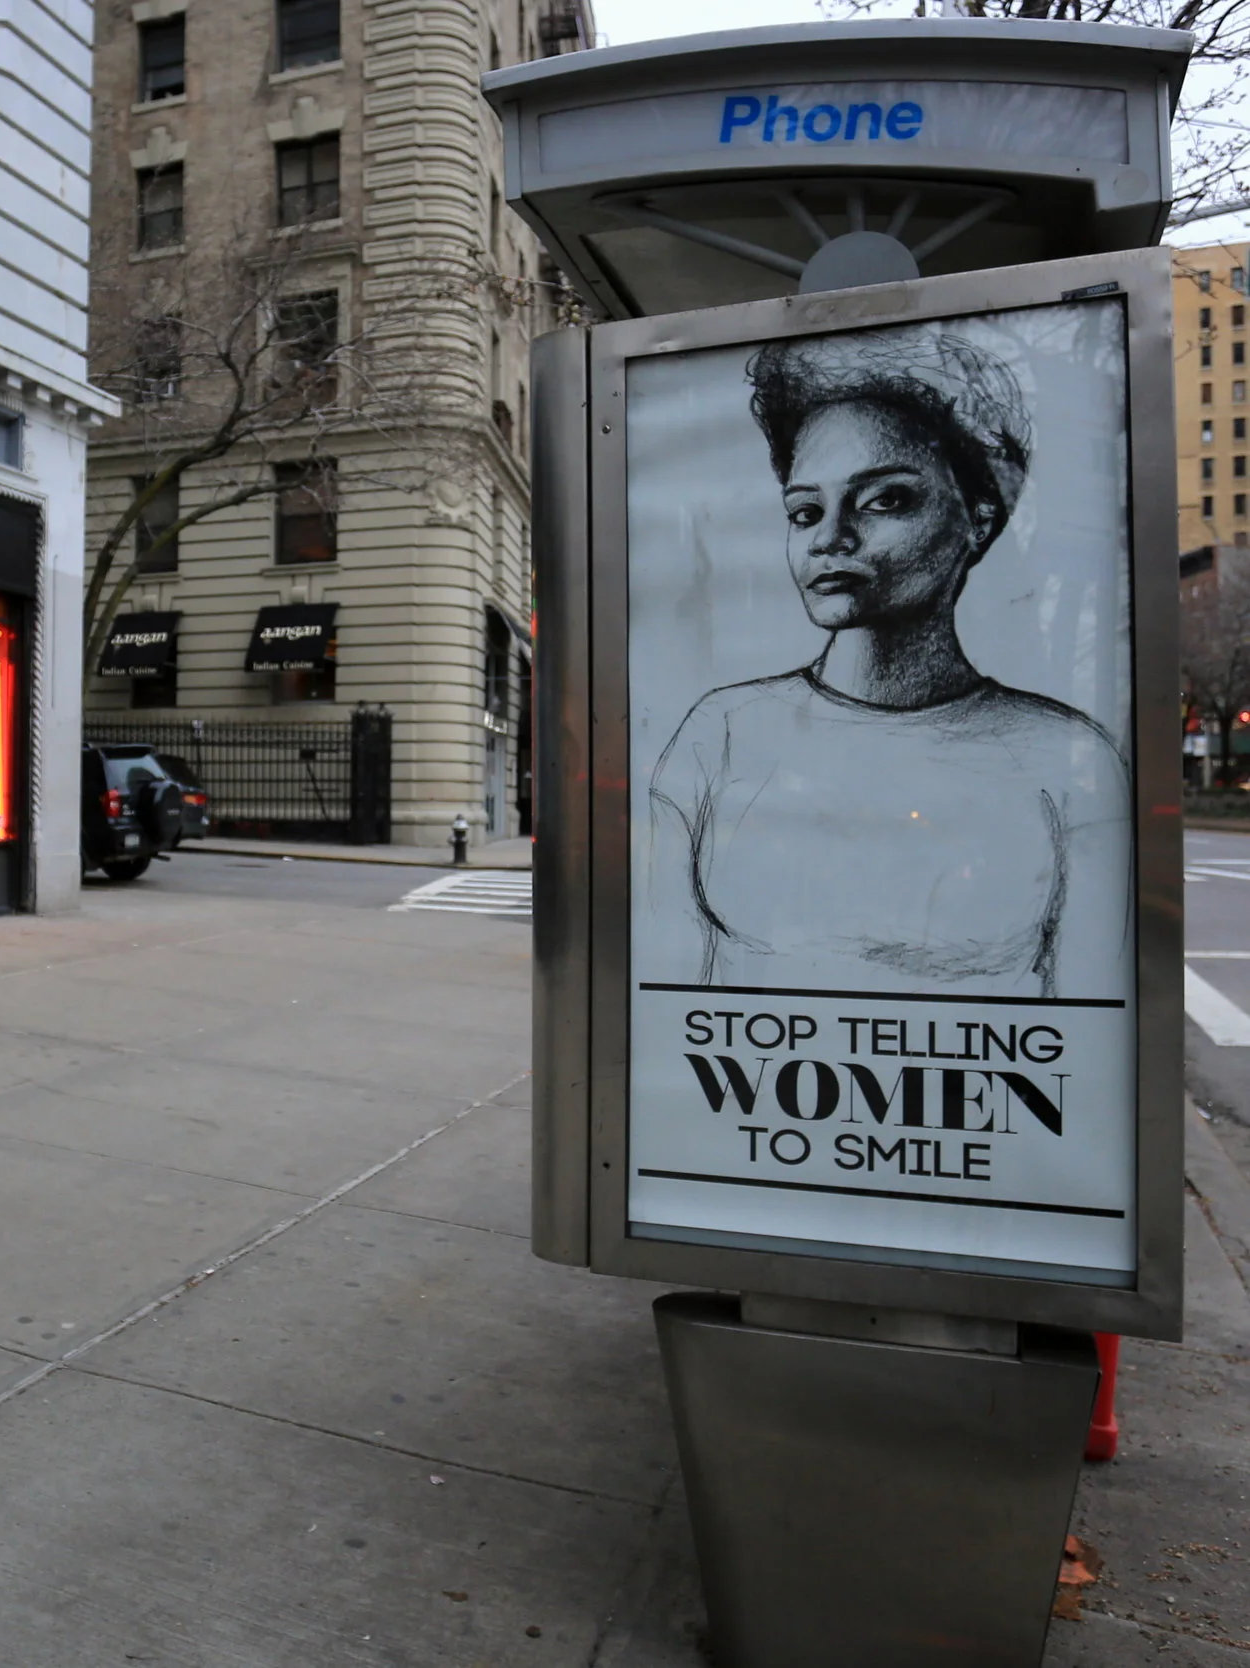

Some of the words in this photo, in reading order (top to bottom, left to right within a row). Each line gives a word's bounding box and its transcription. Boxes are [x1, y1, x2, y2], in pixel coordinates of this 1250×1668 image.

[719, 95, 924, 143] Phone
[111, 632, 168, 647] aangan
[260, 625, 322, 640] aangan
[253, 661, 279, 671] Indian
[685, 1010, 817, 1050] STOP
[838, 1016, 1064, 1064] TELLING
[683, 1053, 1071, 1136] WOMEN
[738, 1125, 811, 1165] TO
[834, 1133, 991, 1181] SMILE
